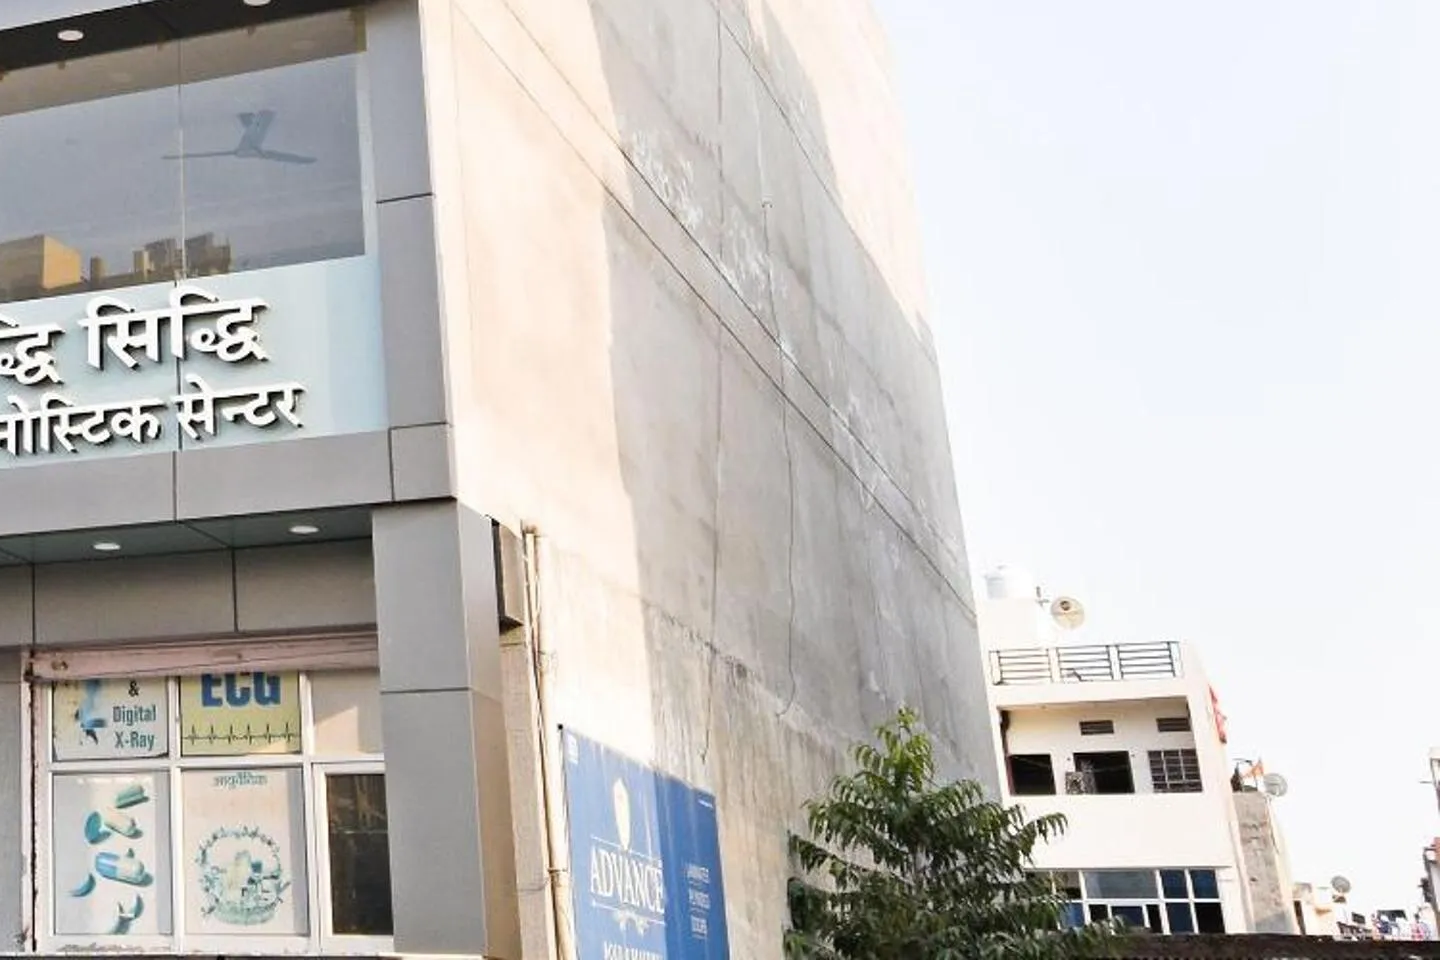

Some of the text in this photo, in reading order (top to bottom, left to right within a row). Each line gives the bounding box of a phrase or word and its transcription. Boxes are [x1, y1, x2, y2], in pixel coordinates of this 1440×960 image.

[77, 285, 271, 372] सिद्धि
[171, 373, 307, 440] सेन्टर
[128, 680, 139, 697] &
[201, 671, 281, 707] ECG
[112, 704, 157, 726] Digital
[115, 731, 155, 751] X-Ray
[590, 845, 665, 914] ADVANCE
